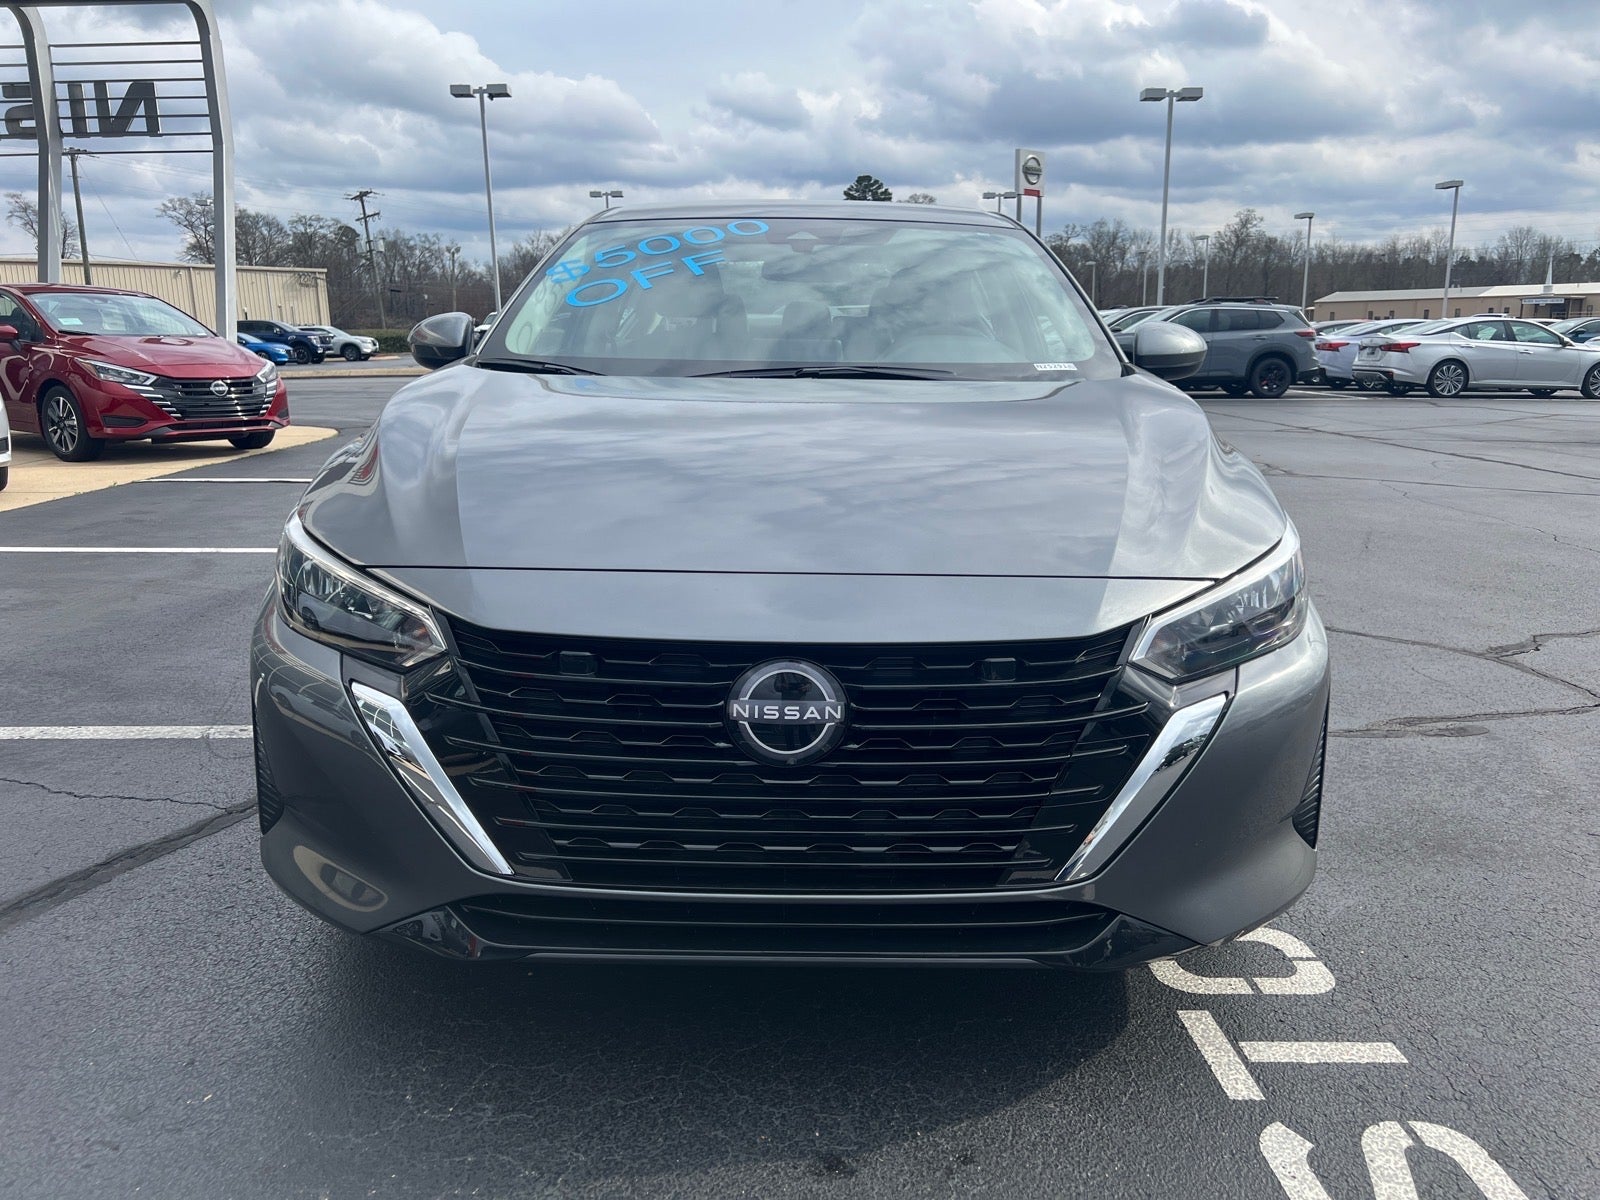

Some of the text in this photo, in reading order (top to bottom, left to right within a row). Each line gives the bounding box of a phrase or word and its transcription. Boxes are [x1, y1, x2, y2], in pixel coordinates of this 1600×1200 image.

[545, 219, 769, 284] $5000
[565, 249, 726, 307] OFF
[732, 703, 842, 720] NISSAN
